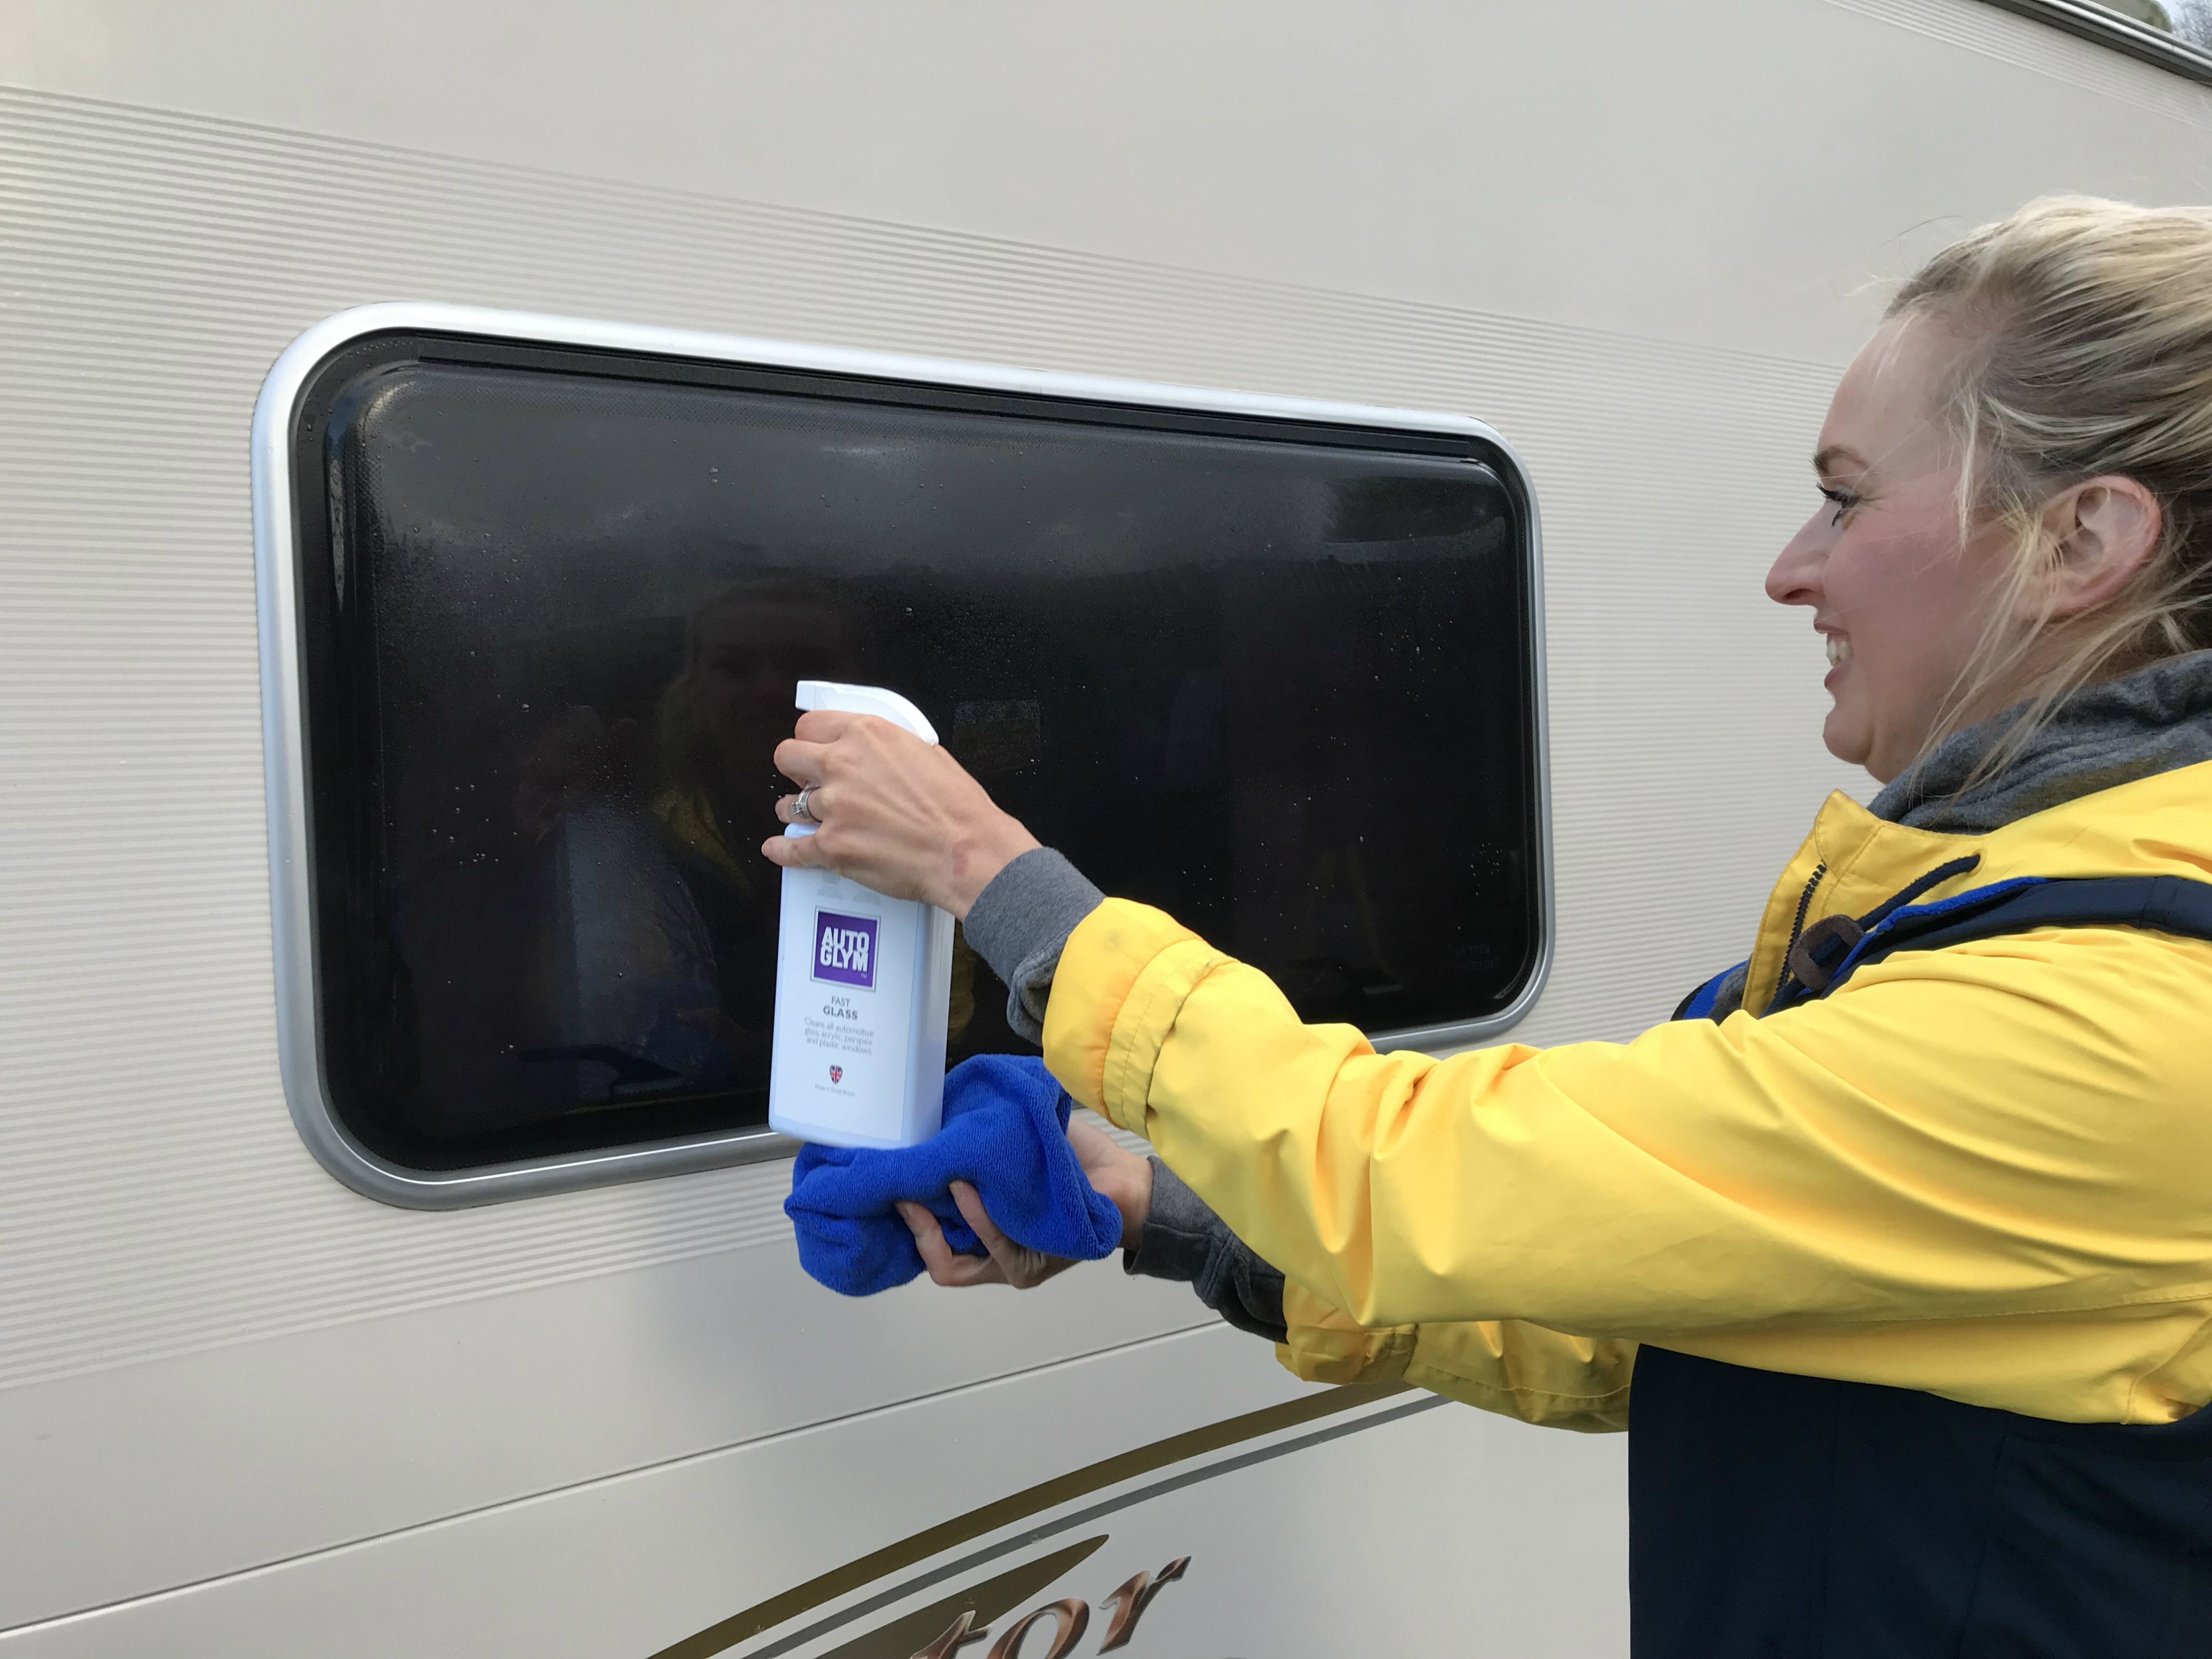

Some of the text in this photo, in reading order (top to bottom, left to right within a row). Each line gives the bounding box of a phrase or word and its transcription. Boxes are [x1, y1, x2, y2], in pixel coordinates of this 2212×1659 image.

[821, 926, 870, 951] AUTO
[820, 946, 868, 972] GLYM
[831, 995, 851, 1008] FAST
[823, 1005, 858, 1020] GLASS
[804, 1016, 825, 1028] Cleans
[836, 1025, 874, 1037] automotive
[806, 1037, 872, 1056] and plastic windows
[844, 1035, 873, 1047] perspex
